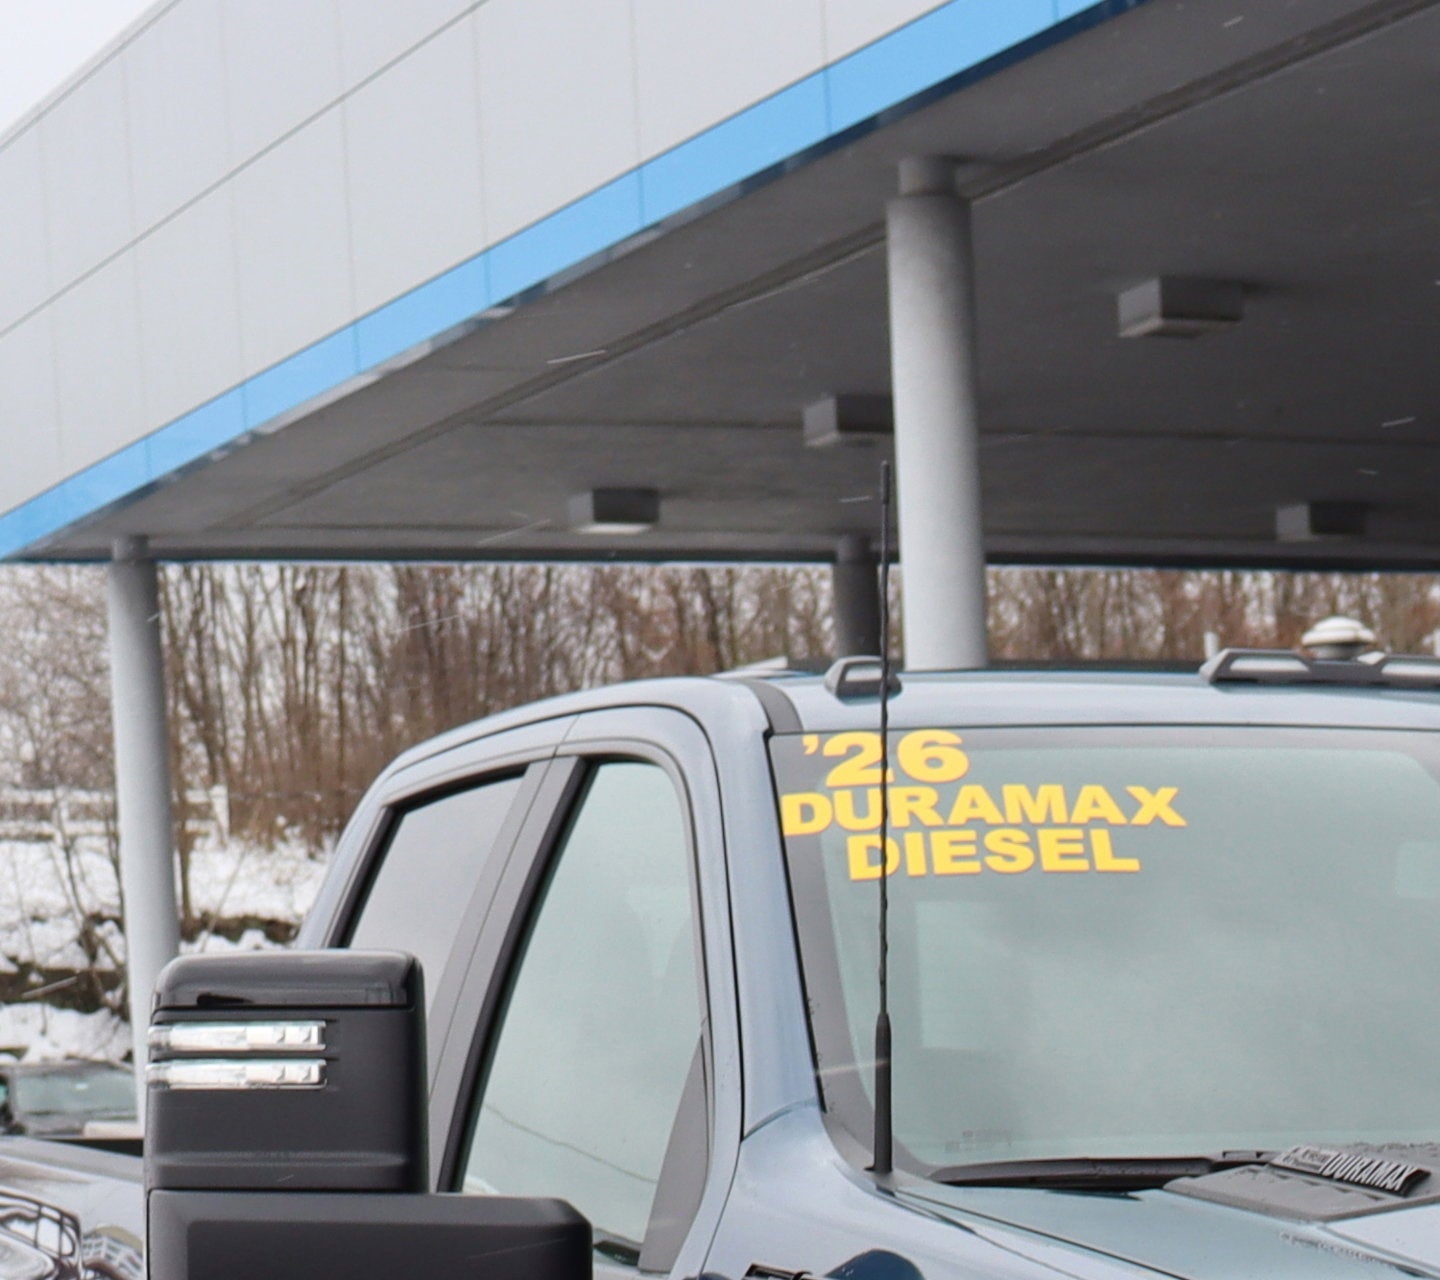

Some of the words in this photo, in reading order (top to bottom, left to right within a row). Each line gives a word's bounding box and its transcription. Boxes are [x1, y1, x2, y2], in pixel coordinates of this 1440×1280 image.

[779, 783, 1187, 837] DURAMAX
[846, 827, 1141, 881] DIESEL
[1322, 1151, 1420, 1192] DURAMAX
